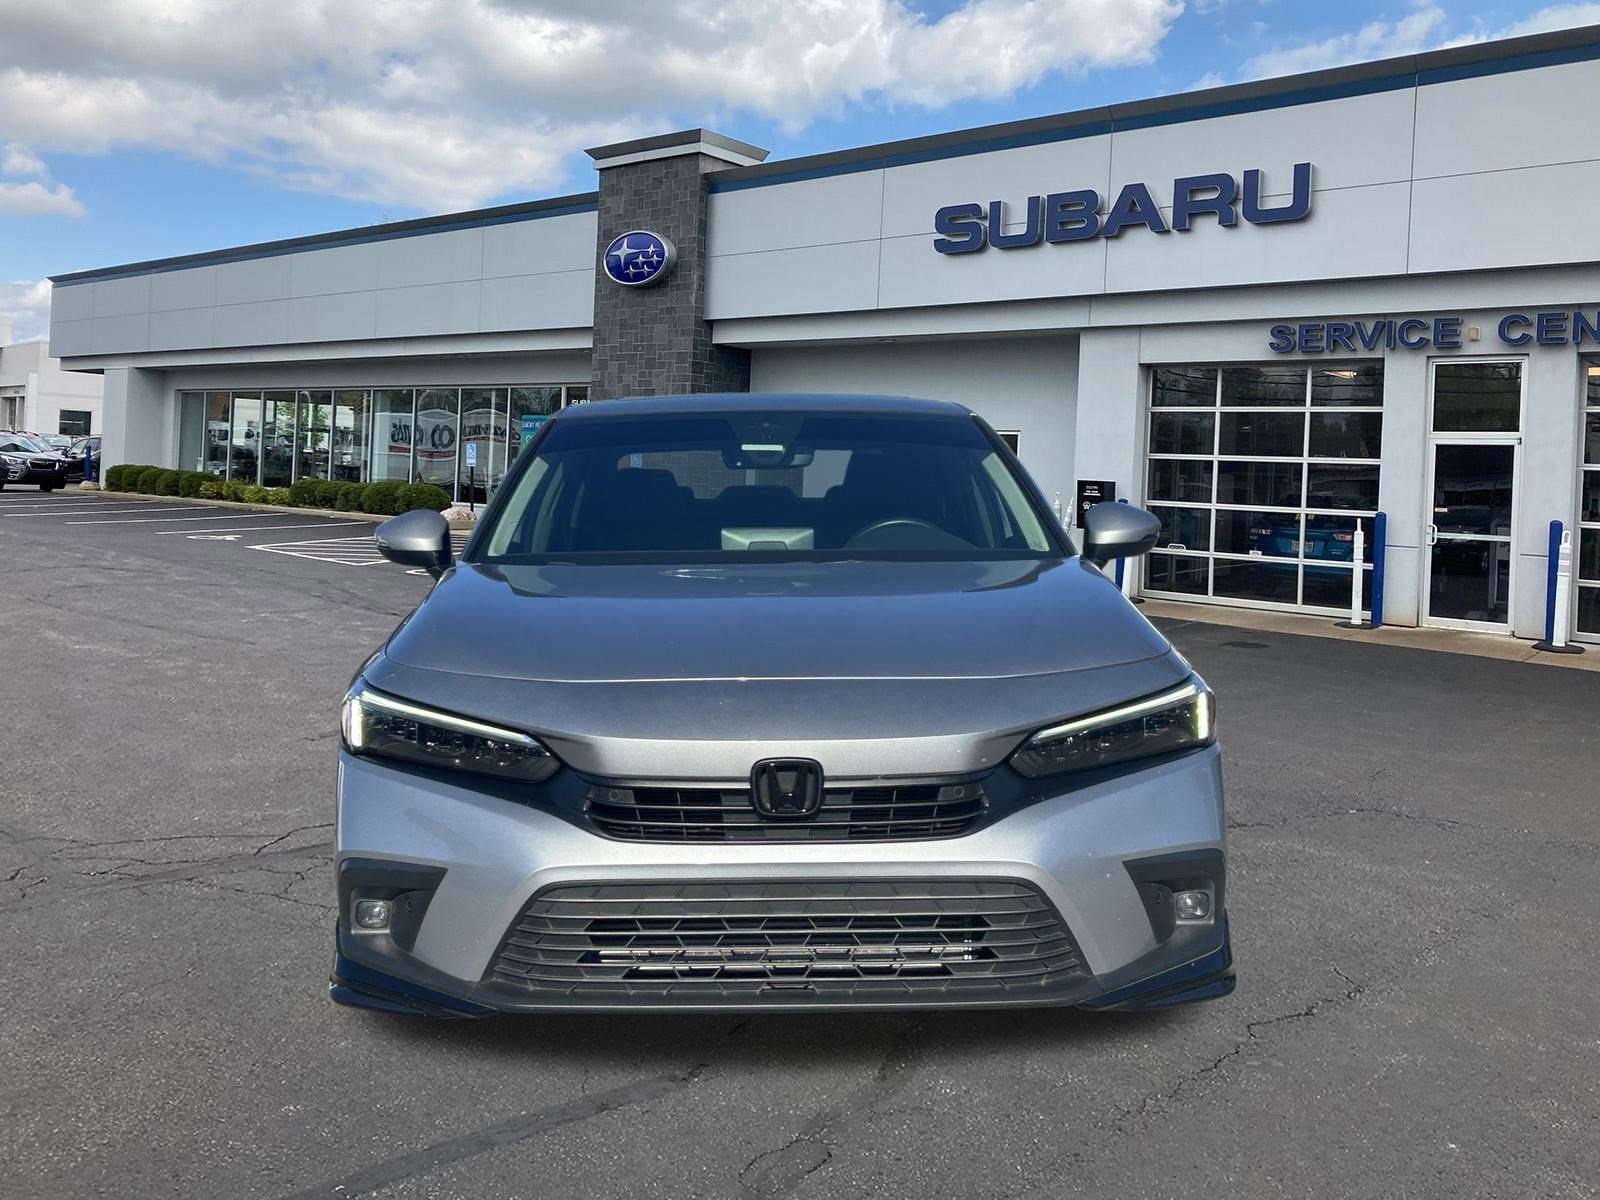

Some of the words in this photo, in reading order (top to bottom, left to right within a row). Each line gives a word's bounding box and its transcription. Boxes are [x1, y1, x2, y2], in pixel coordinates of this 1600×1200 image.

[933, 162, 1312, 255] SUBARU
[1268, 317, 1463, 353] SERVICE
[1497, 311, 1600, 345] CEN
